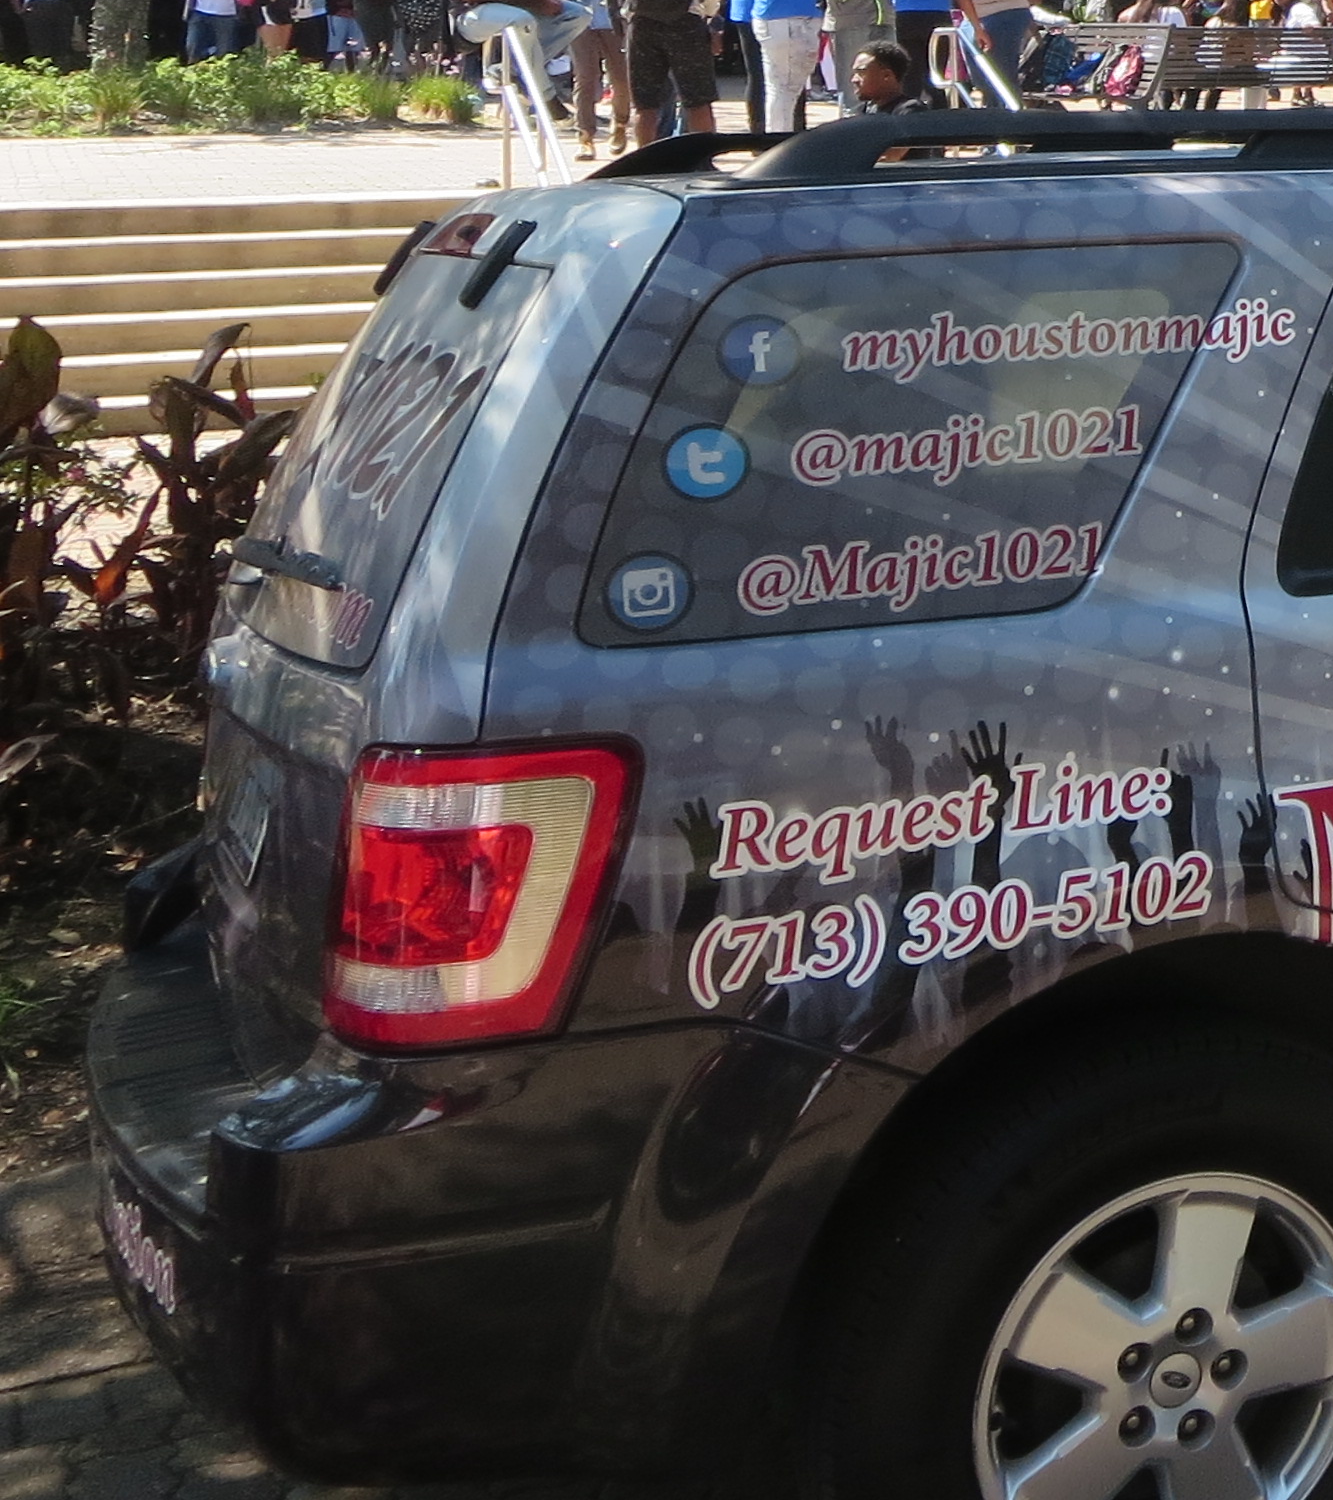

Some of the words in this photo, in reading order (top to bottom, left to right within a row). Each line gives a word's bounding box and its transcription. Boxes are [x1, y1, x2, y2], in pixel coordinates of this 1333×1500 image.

[844, 298, 1296, 382] myhoustonmajic
[790, 404, 1143, 486] @majic1021
[737, 523, 1106, 615] @Majic1021
[709, 774, 999, 885] Request
[1010, 752, 1173, 836] Line:
[687, 893, 887, 1010] (713)
[898, 850, 1214, 966] 390-5102
